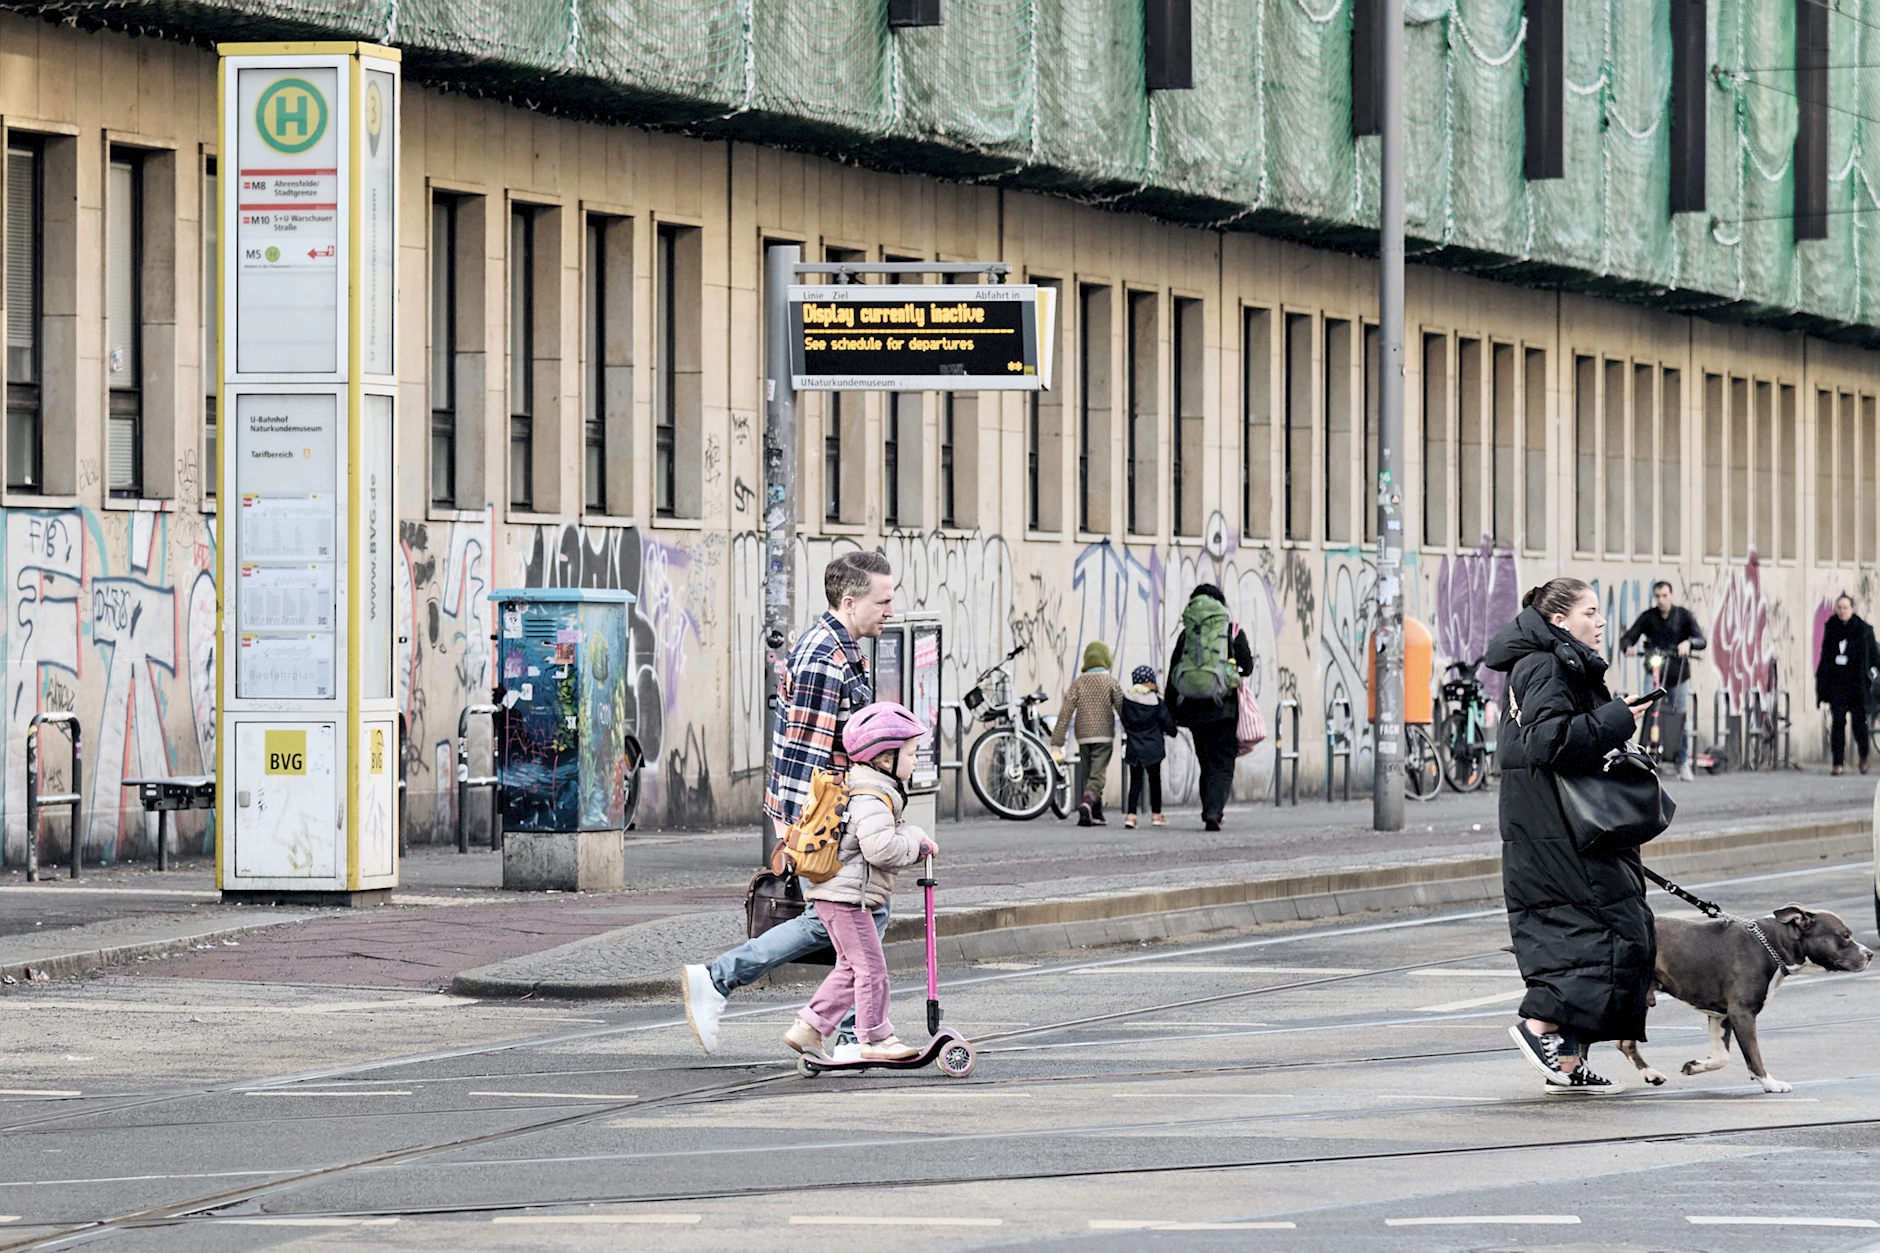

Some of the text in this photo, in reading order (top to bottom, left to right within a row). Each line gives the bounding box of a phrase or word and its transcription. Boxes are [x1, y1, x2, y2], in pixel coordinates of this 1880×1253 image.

[276, 96, 307, 136] H
[252, 181, 266, 190] M8
[274, 189, 318, 198] Stadtgrenze
[251, 216, 270, 225] M10
[246, 249, 261, 259] M5
[803, 291, 1020, 300] Linie Ziel Abfahrt in
[803, 303, 985, 328] Display currently inactive
[804, 337, 975, 352] See schedule for departures
[250, 670, 315, 681] Baufahrplan
[270, 753, 302, 770] BVG
[372, 752, 382, 769] BVG
